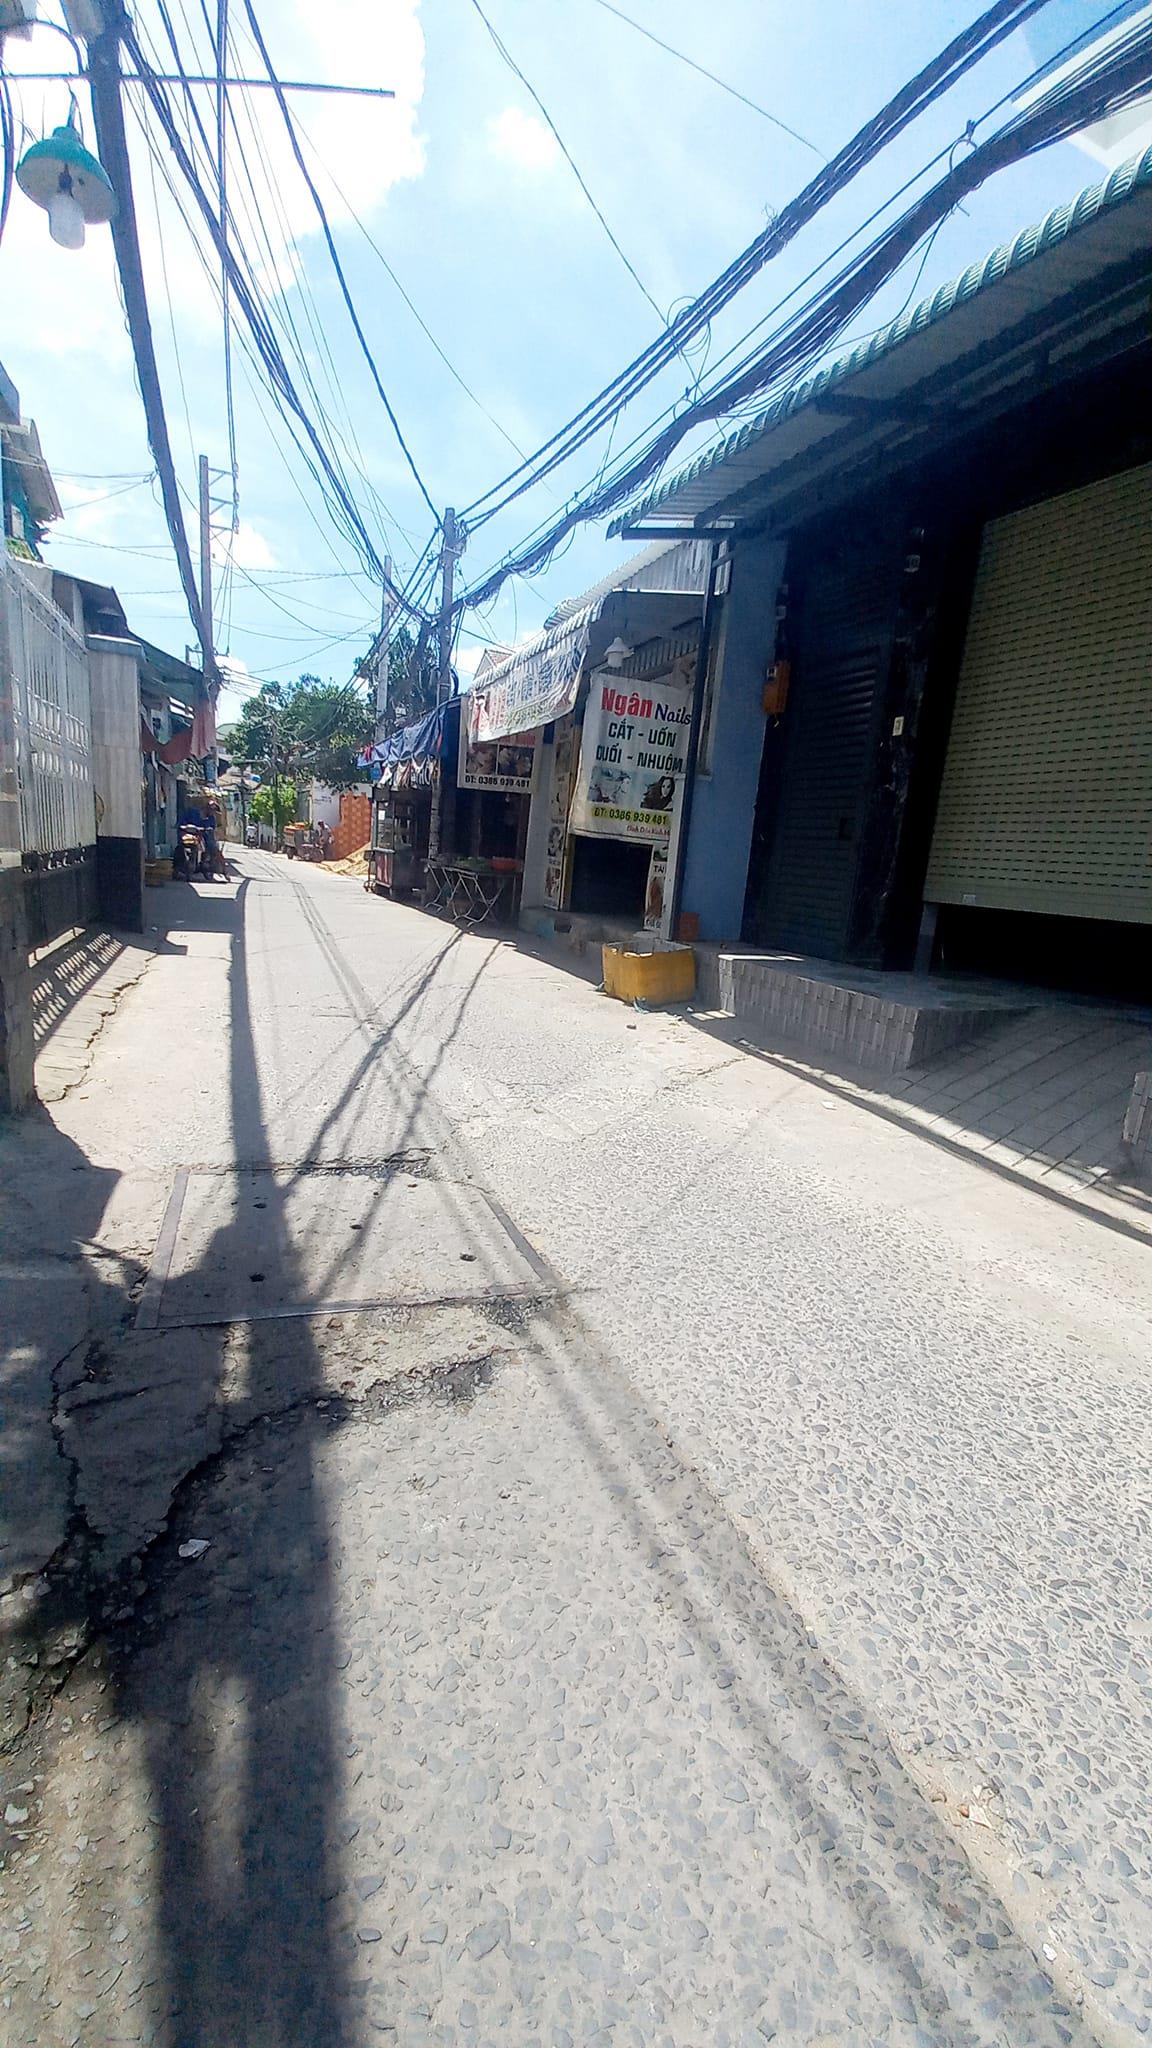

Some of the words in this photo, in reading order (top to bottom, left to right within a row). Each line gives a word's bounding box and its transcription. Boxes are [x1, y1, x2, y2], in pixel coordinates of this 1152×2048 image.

[602, 687, 652, 718] Ngân
[655, 703, 692, 725] Nails
[608, 718, 635, 741] CẮT
[648, 726, 677, 748] UỐN
[637, 752, 683, 775] NHUỘM
[633, 814, 651, 824] 939
